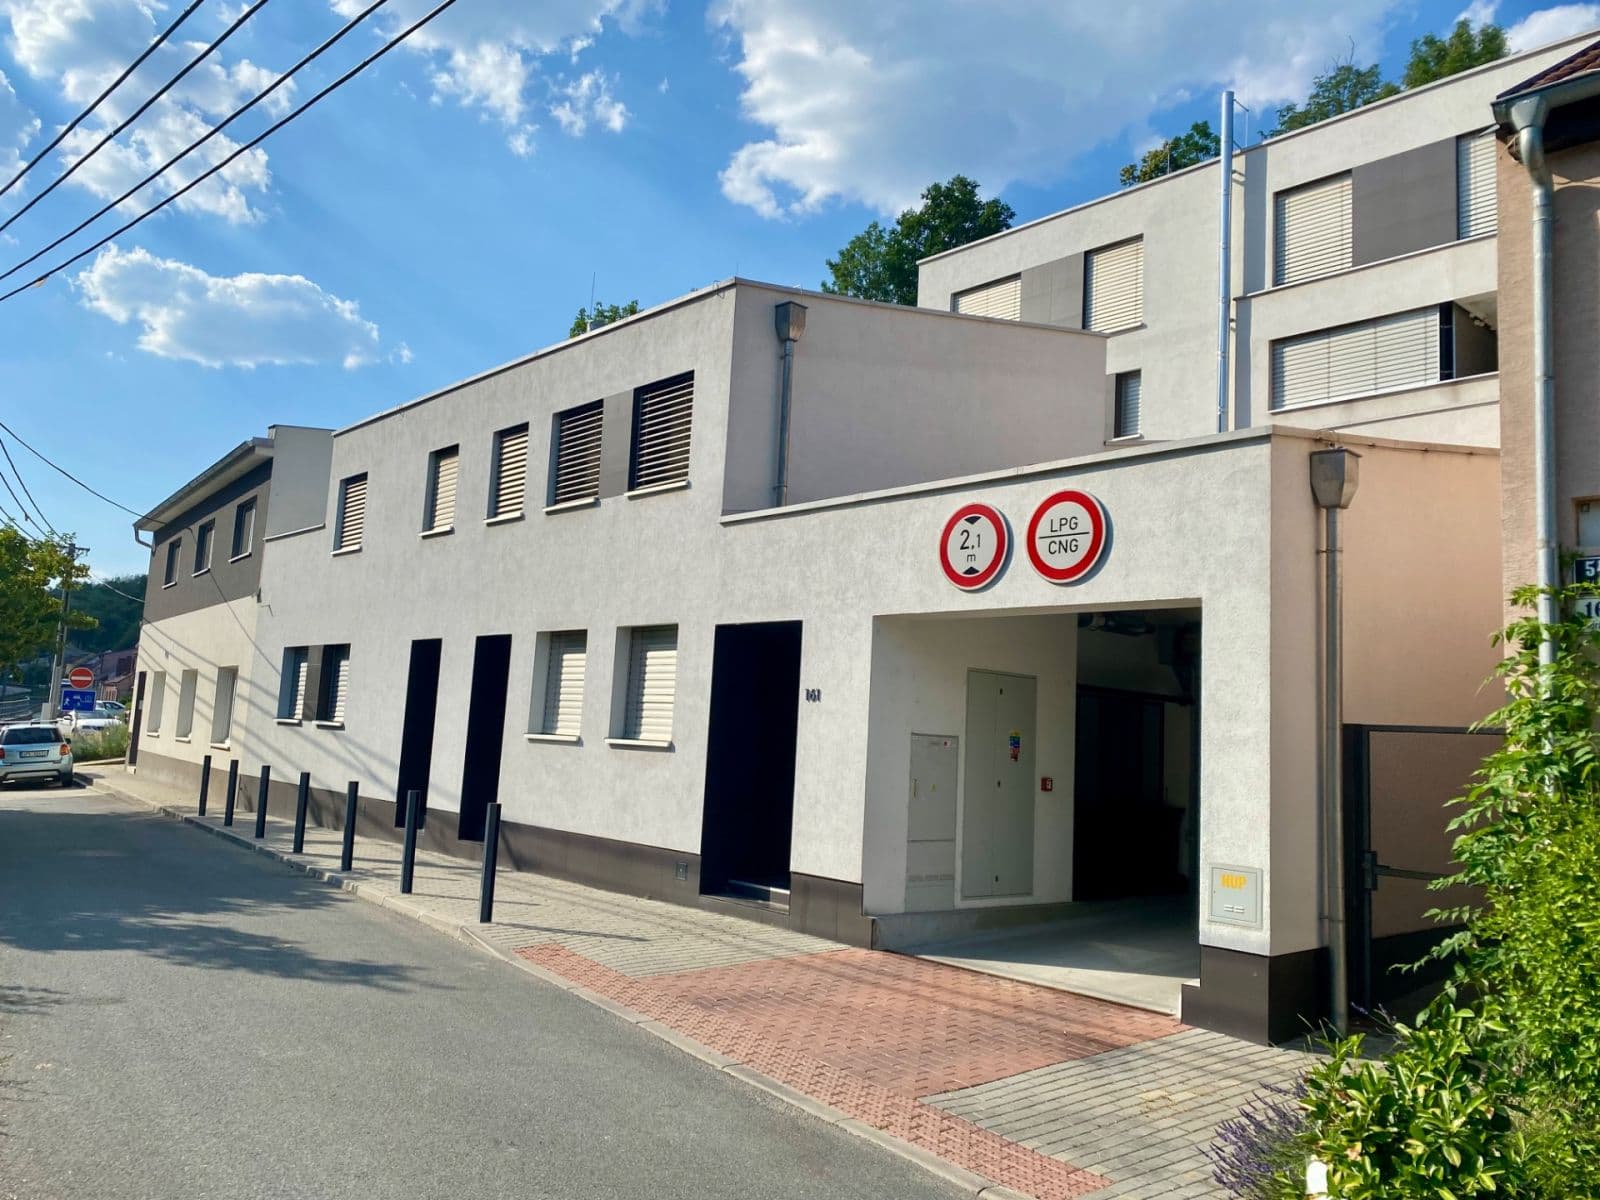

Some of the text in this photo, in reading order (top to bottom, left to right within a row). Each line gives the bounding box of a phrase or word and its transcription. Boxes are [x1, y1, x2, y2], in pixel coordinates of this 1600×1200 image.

[1050, 516, 1079, 533] LPG
[959, 529, 981, 551] 2,1
[1048, 538, 1079, 555] CNG
[966, 552, 977, 563] m
[1585, 560, 1600, 577] 5
[1221, 873, 1248, 889] HUP
